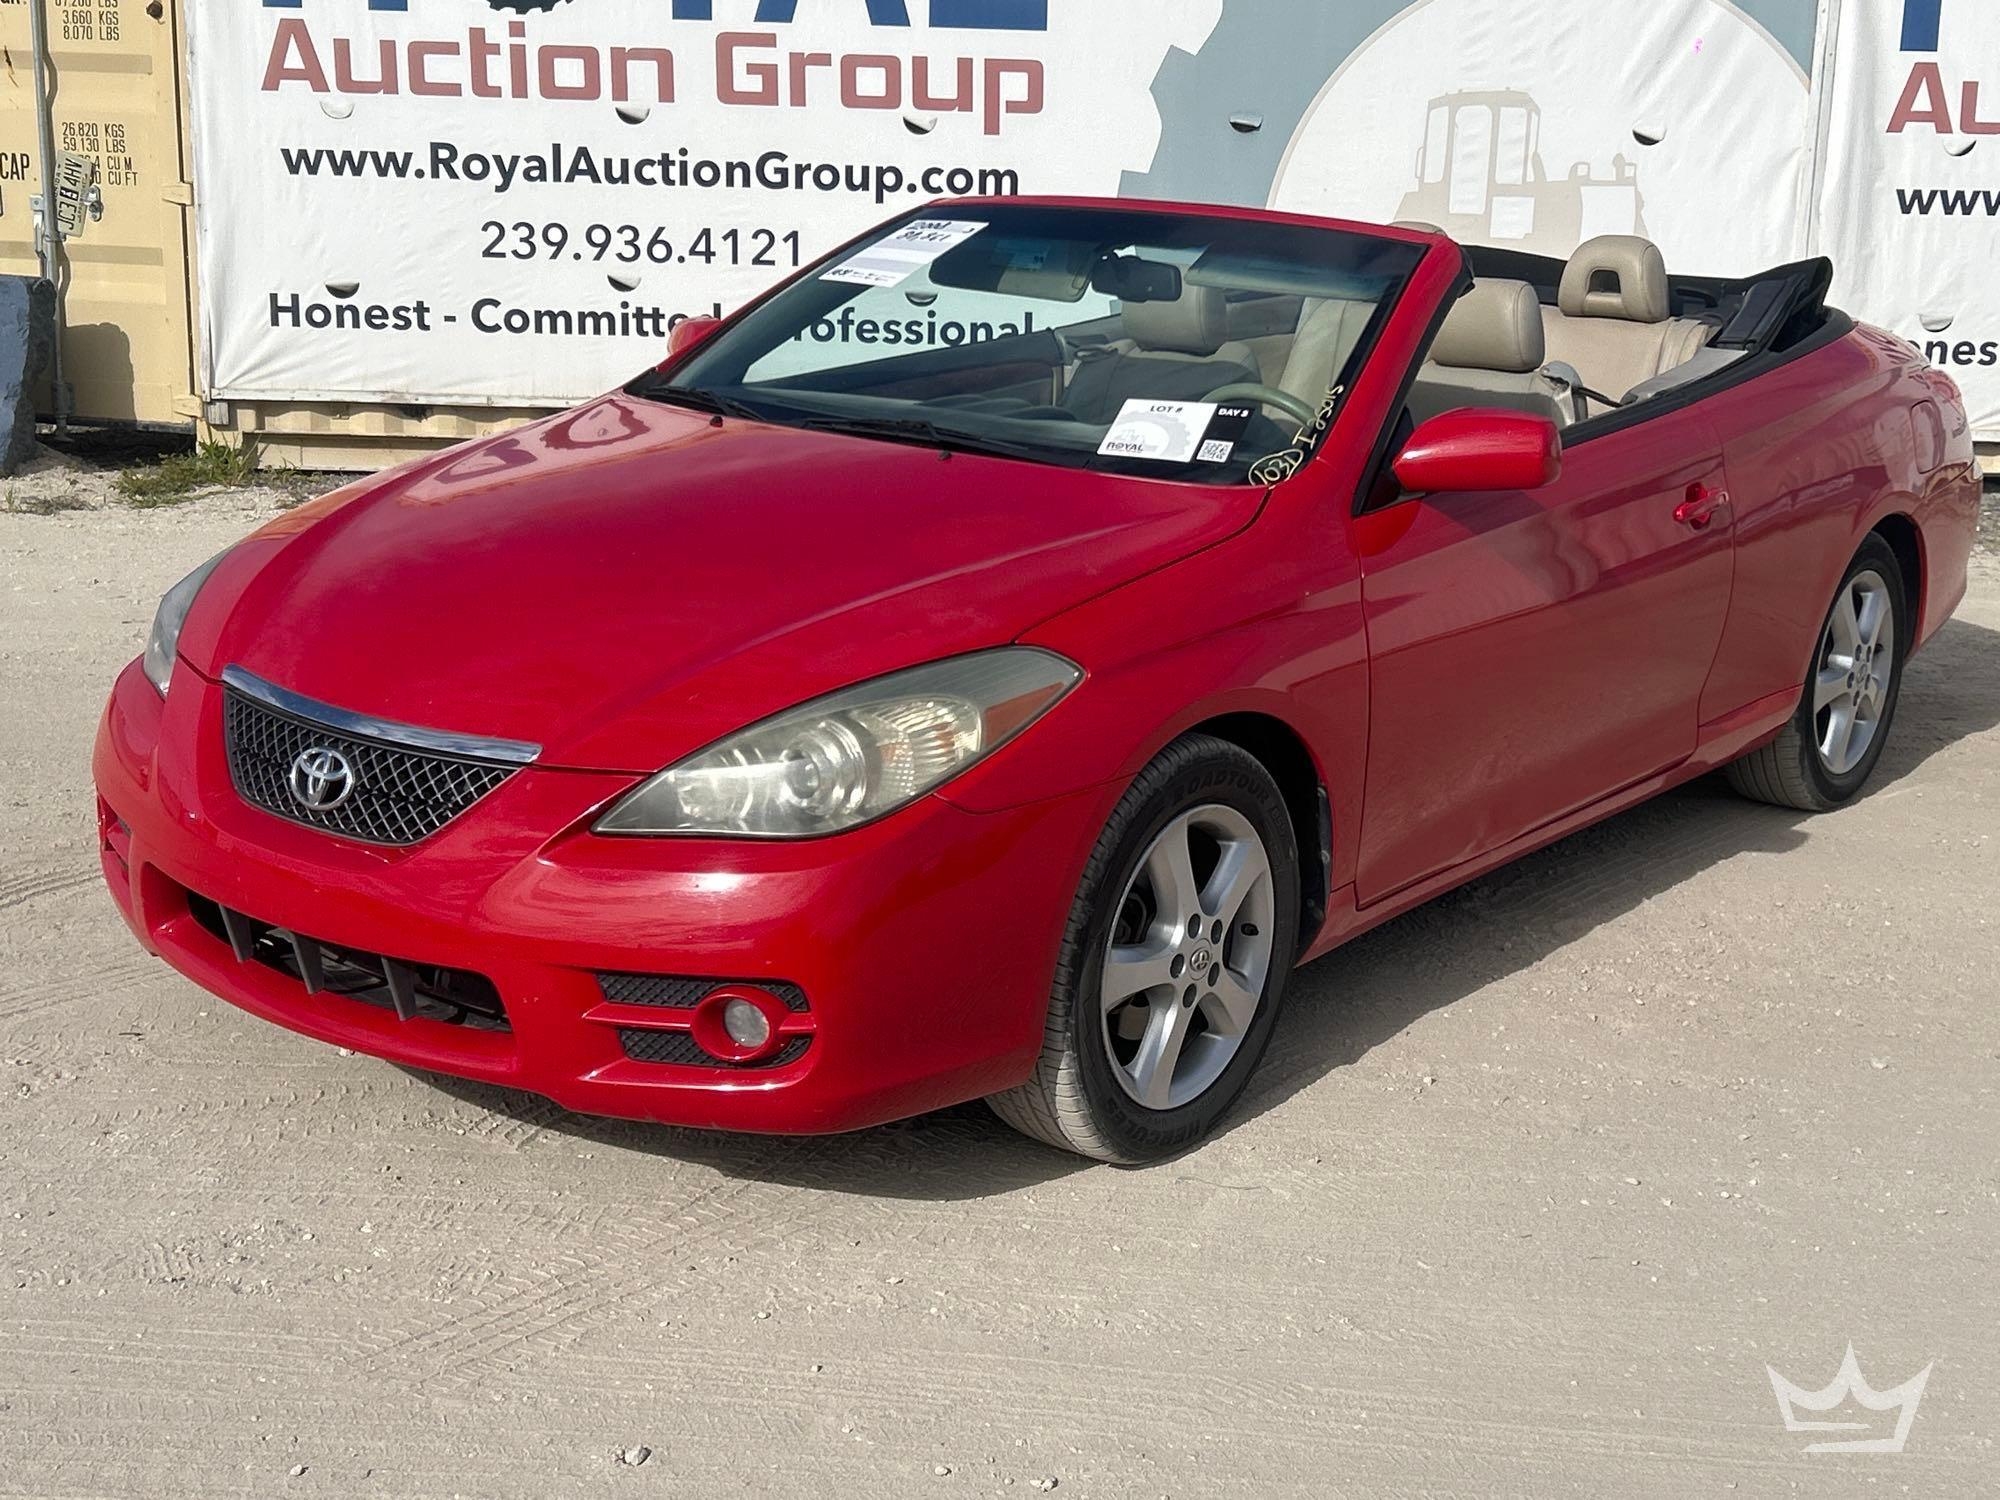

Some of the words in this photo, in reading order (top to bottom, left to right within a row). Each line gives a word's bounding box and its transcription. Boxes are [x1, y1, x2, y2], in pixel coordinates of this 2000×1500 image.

[62, 10, 92, 25] 3.660
[98, 11, 119, 26] KGS
[63, 25, 93, 40] 8.070
[99, 27, 120, 41] LBS
[261, 18, 675, 104] Auction
[715, 31, 1044, 136] Group
[61, 122, 98, 137] 26.820
[104, 123, 125, 138] KGS
[105, 139, 126, 154] LBS
[280, 141, 1019, 204] www.RoyalAuctionGroup.com
[481, 220, 799, 266] 239.936.4121
[269, 293, 430, 331] Honest
[1907, 340, 1999, 366] nes
[1150, 405, 1174, 413] LOT
[1218, 408, 1240, 416] DAY
